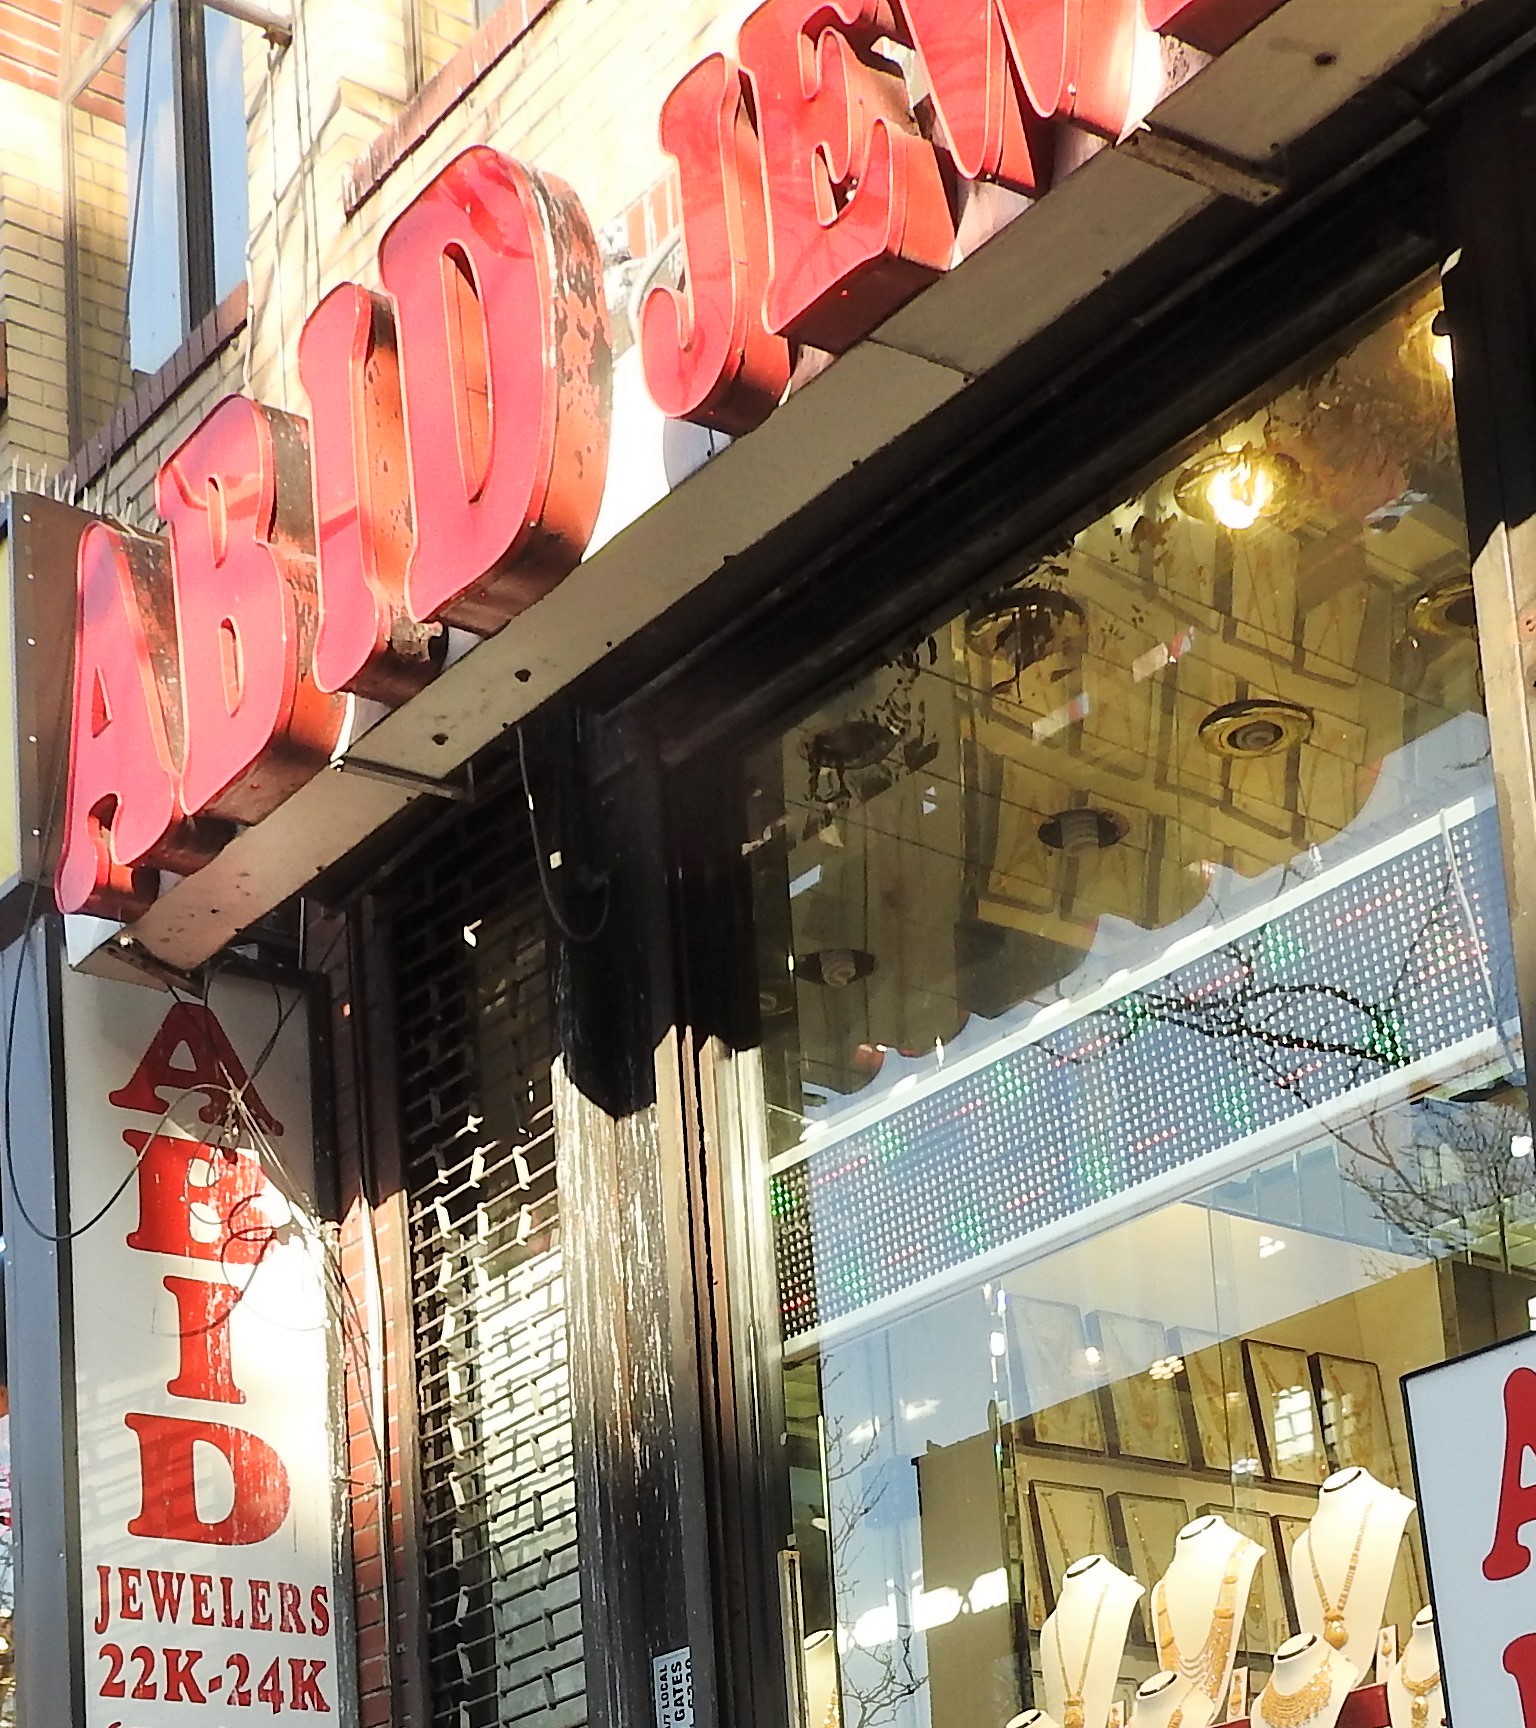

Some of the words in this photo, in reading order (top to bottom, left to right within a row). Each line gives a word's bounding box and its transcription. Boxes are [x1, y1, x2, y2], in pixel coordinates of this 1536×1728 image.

[54, 145, 594, 915] ABID
[641, 0, 1264, 425] JEW
[109, 1000, 292, 1547] ABID
[94, 1565, 332, 1637] JEWELERS
[99, 1643, 332, 1716] 22K-24K
[671, 1660, 687, 1723] GATES
